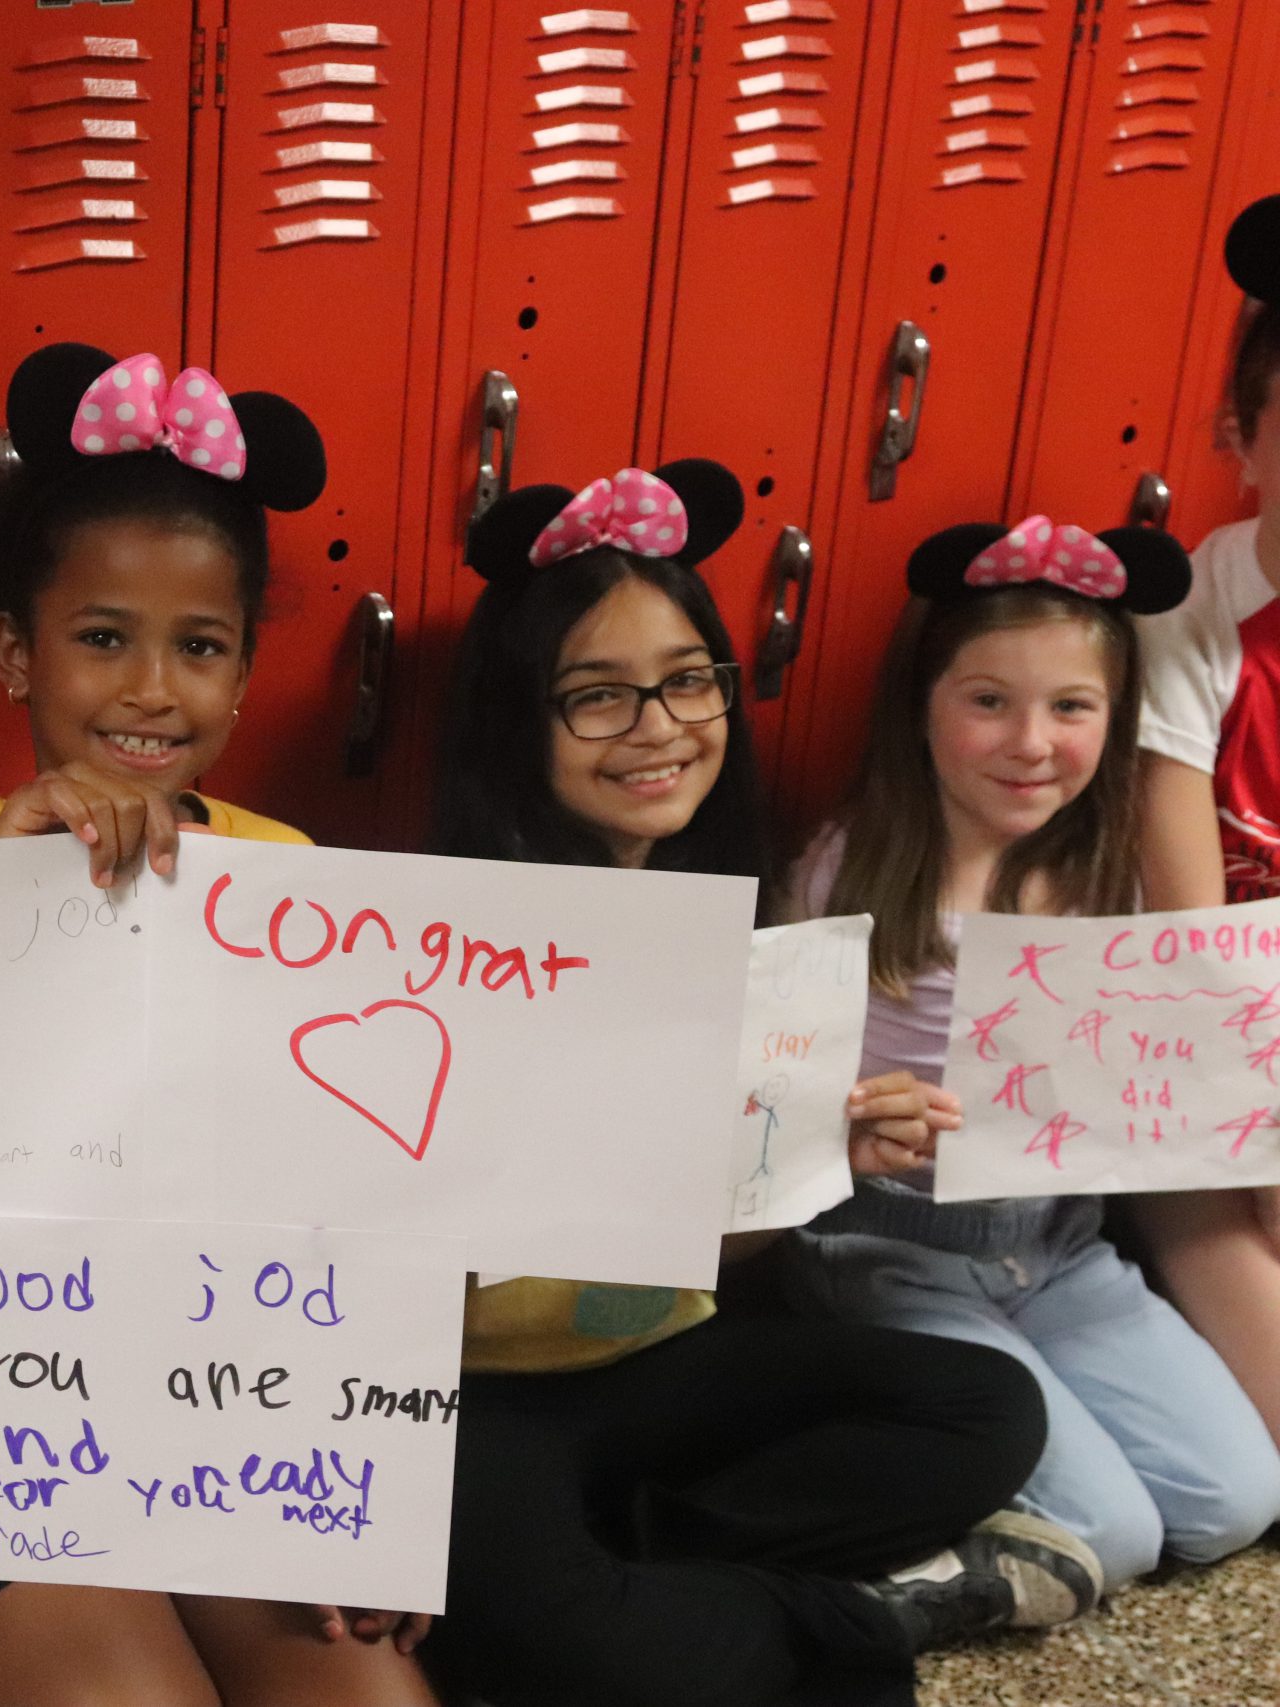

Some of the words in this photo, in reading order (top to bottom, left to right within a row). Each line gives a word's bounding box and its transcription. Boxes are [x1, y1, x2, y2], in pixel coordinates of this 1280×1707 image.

[204, 872, 591, 1000] Congrat
[1121, 1076, 1173, 1110] did
[69, 1132, 123, 1168] and
[188, 1253, 346, 1327] jod
[166, 1361, 292, 1410] are
[282, 1502, 373, 1540] next
